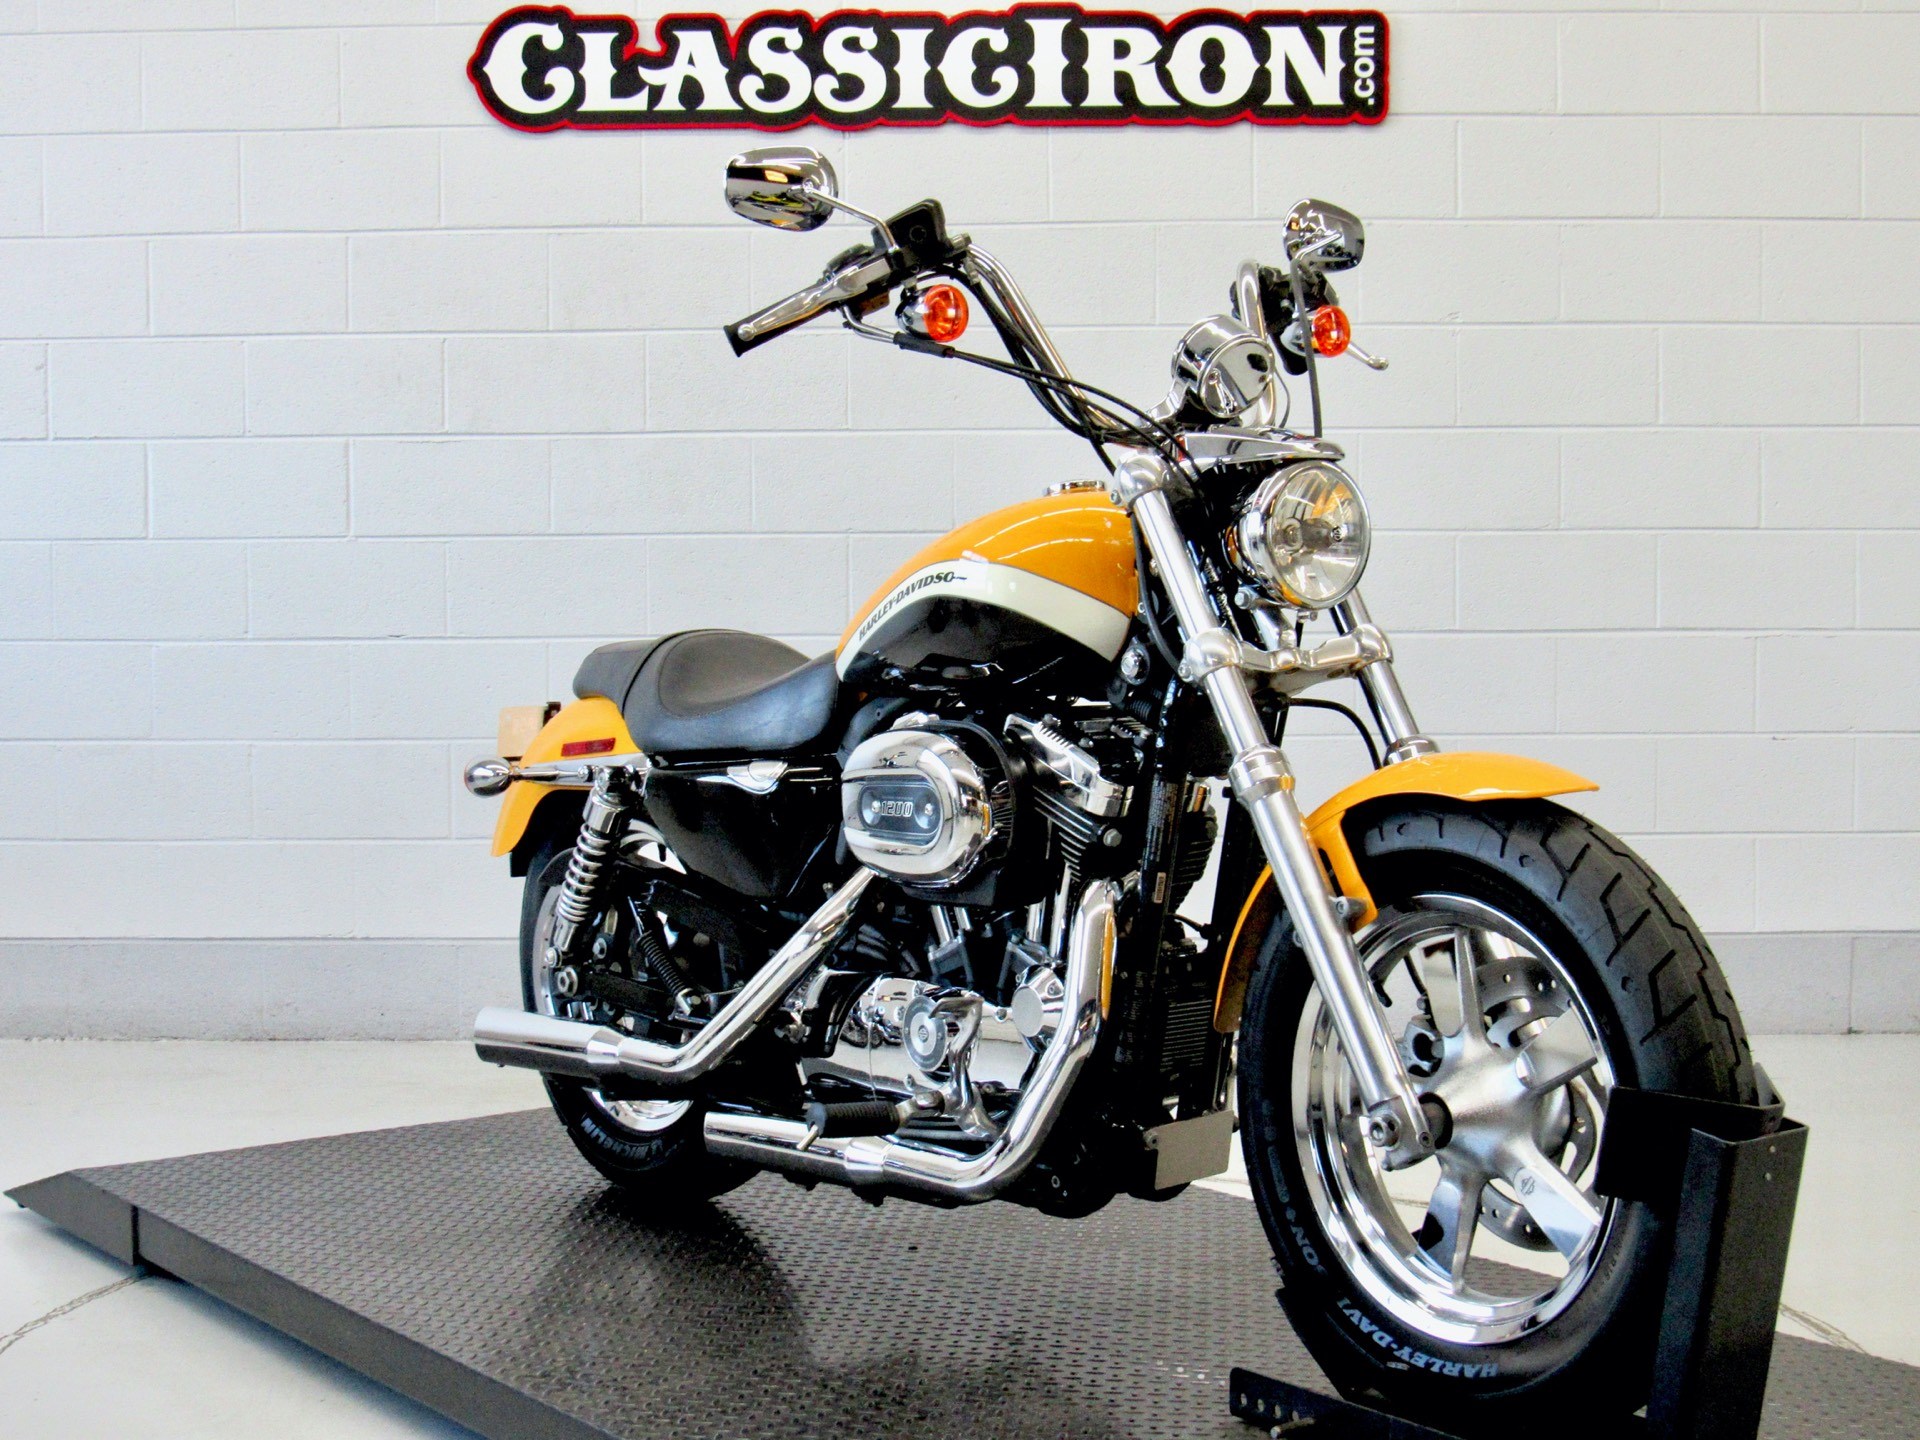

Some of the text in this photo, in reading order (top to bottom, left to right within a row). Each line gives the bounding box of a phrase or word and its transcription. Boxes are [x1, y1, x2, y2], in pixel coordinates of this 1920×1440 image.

[1354, 25, 1375, 106] .com
[858, 571, 967, 641] HARLEY-DAVIDSO
[881, 800, 914, 818] 1200
